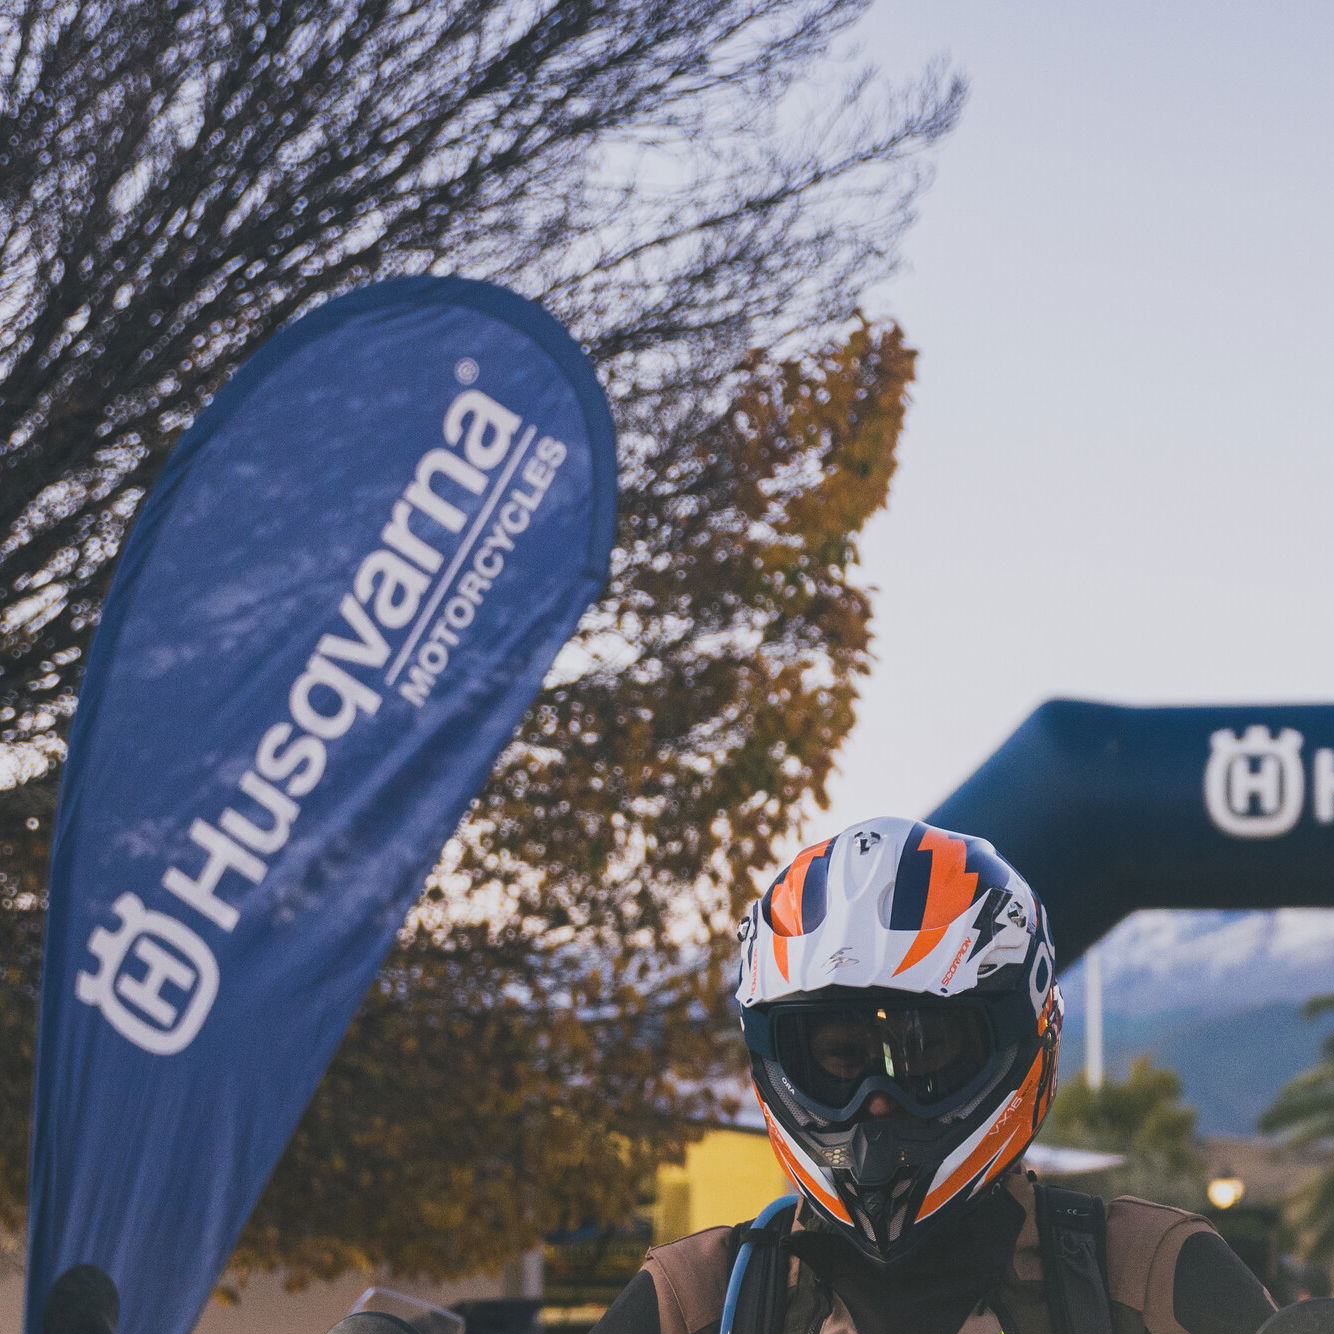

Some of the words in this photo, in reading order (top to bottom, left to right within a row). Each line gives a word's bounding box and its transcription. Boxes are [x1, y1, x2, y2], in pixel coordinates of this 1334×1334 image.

[162, 388, 525, 933] Husqvarna
[402, 434, 569, 709] MOTORCYCLES
[941, 936, 971, 987] SCORPION
